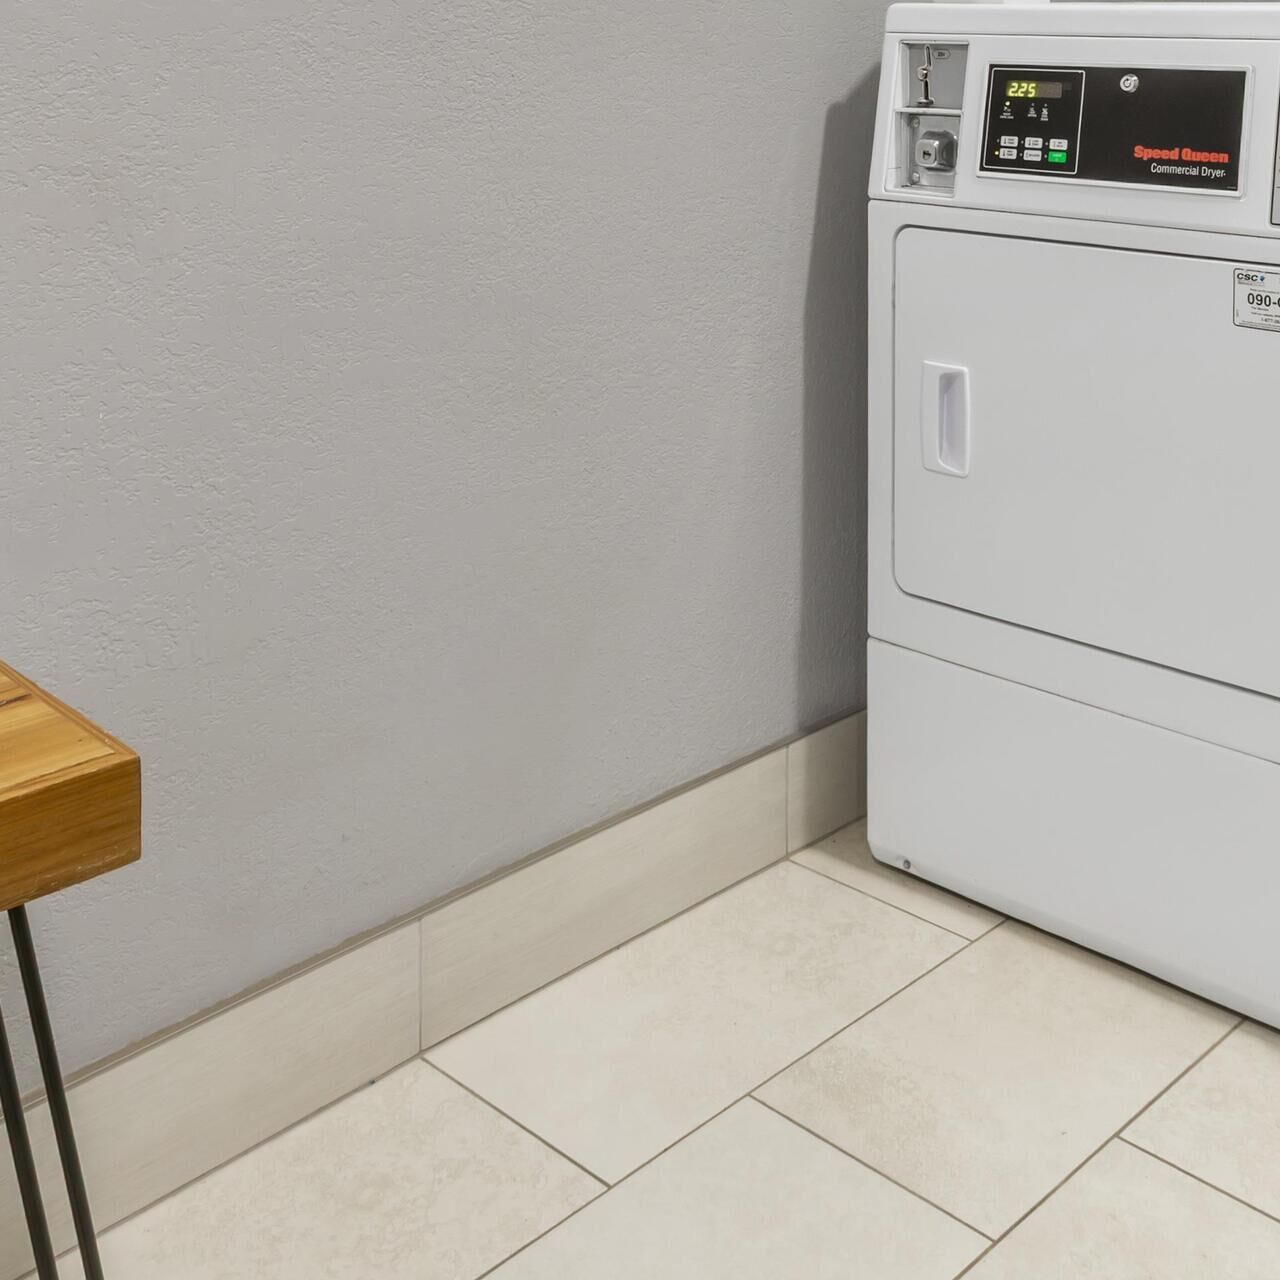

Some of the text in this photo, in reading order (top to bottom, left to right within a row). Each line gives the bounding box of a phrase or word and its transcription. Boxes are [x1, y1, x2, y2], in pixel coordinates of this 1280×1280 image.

[1134, 146, 1228, 163] Speed Queen
[1151, 163, 1199, 175] Commercial
[1237, 272, 1258, 281] CSC
